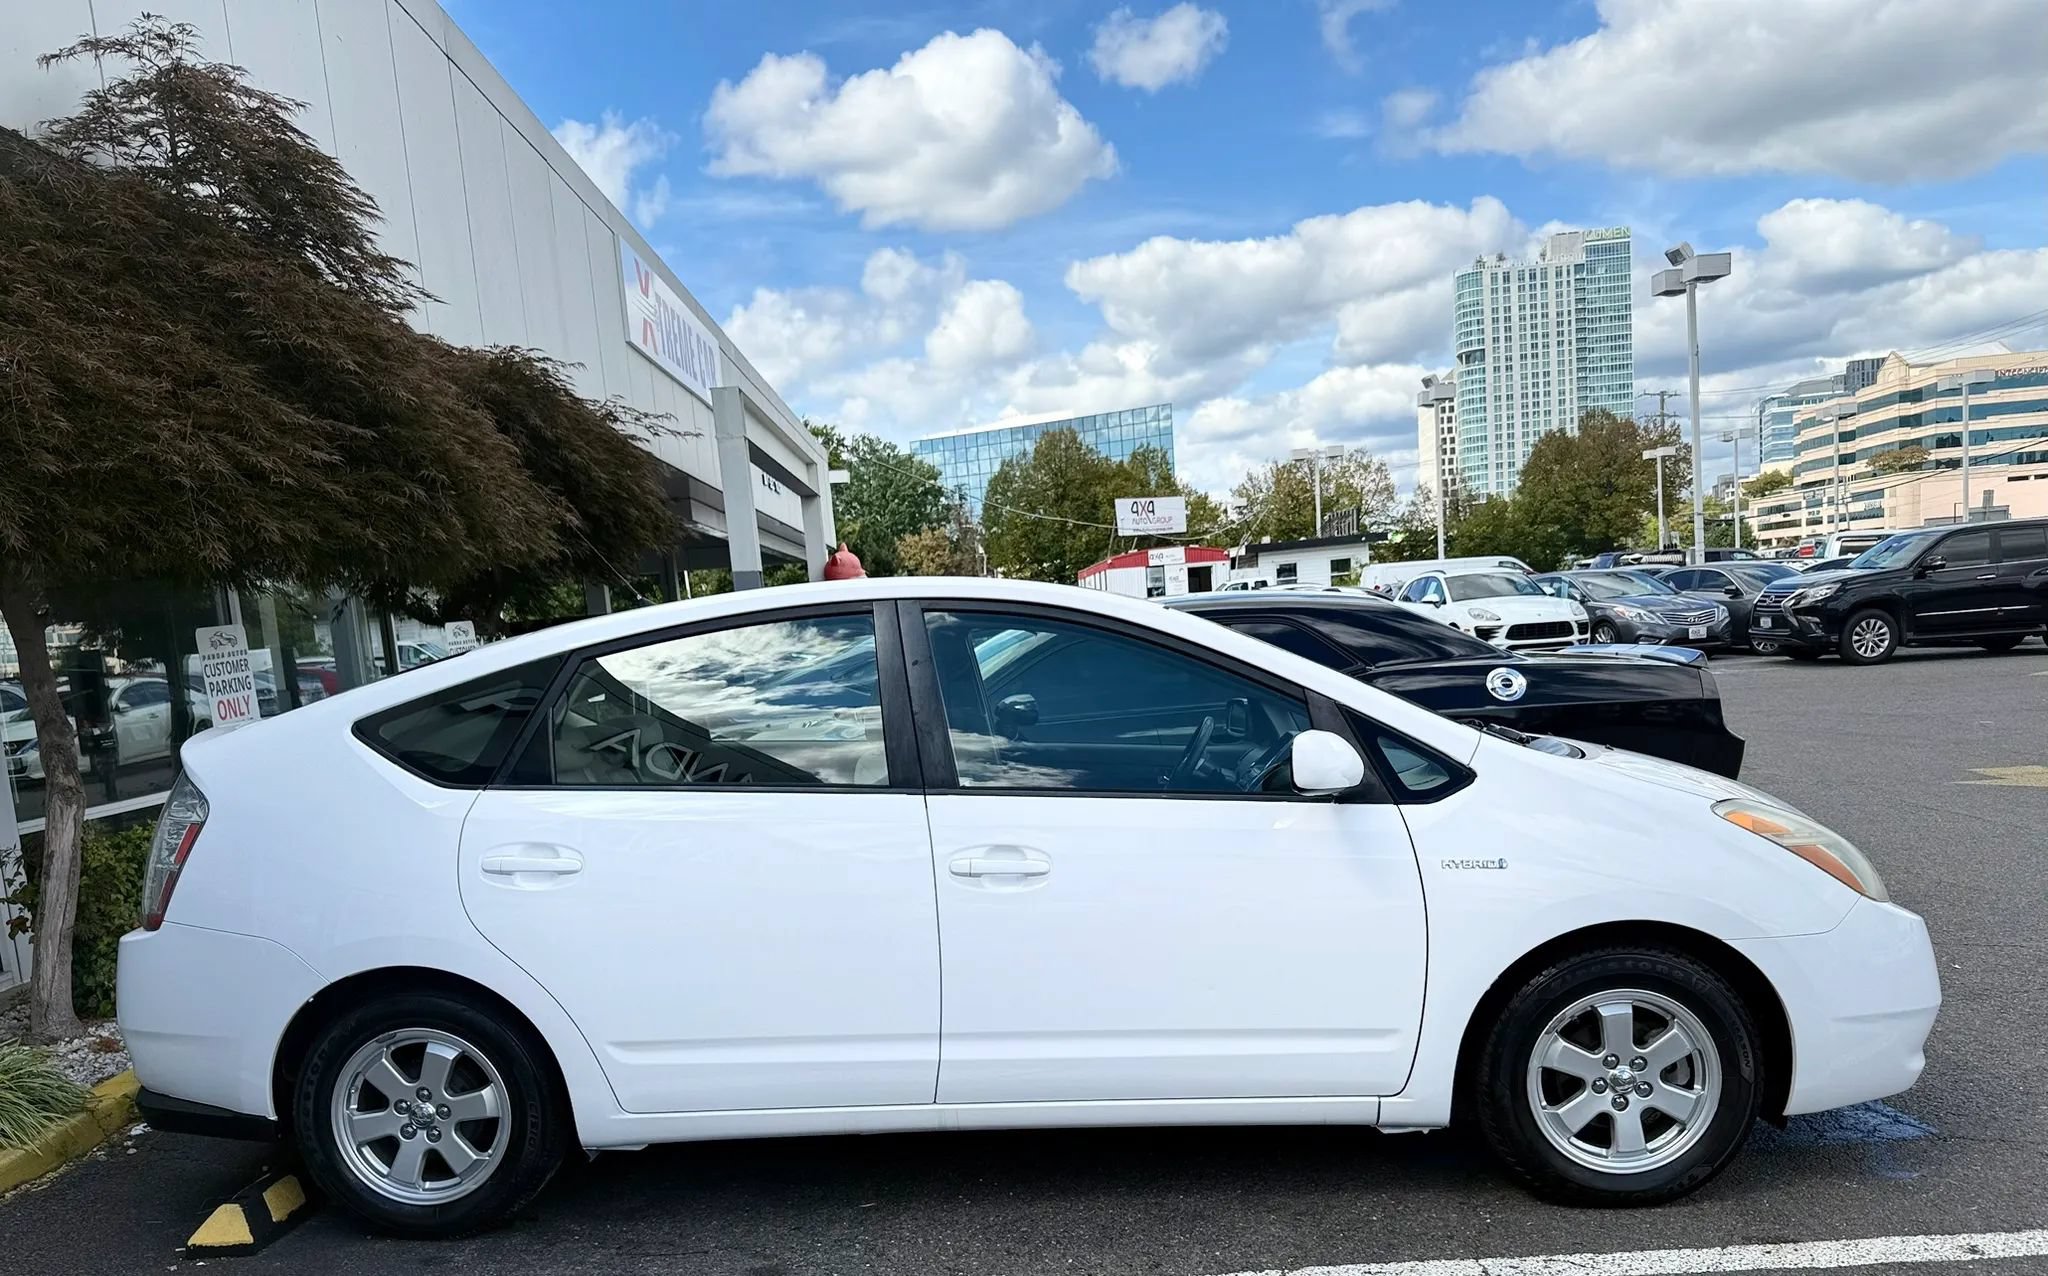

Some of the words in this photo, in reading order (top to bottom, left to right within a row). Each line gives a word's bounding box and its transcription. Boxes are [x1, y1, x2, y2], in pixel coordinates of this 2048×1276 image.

[1585, 226, 1631, 240] LUMEN
[1132, 517, 1148, 525] AUTO
[1152, 516, 1173, 525] GROUP
[203, 658, 250, 678] CUSTOMER
[209, 675, 252, 698] PARKING
[217, 695, 250, 720] ONLY
[1441, 859, 1499, 869] HYBRID
